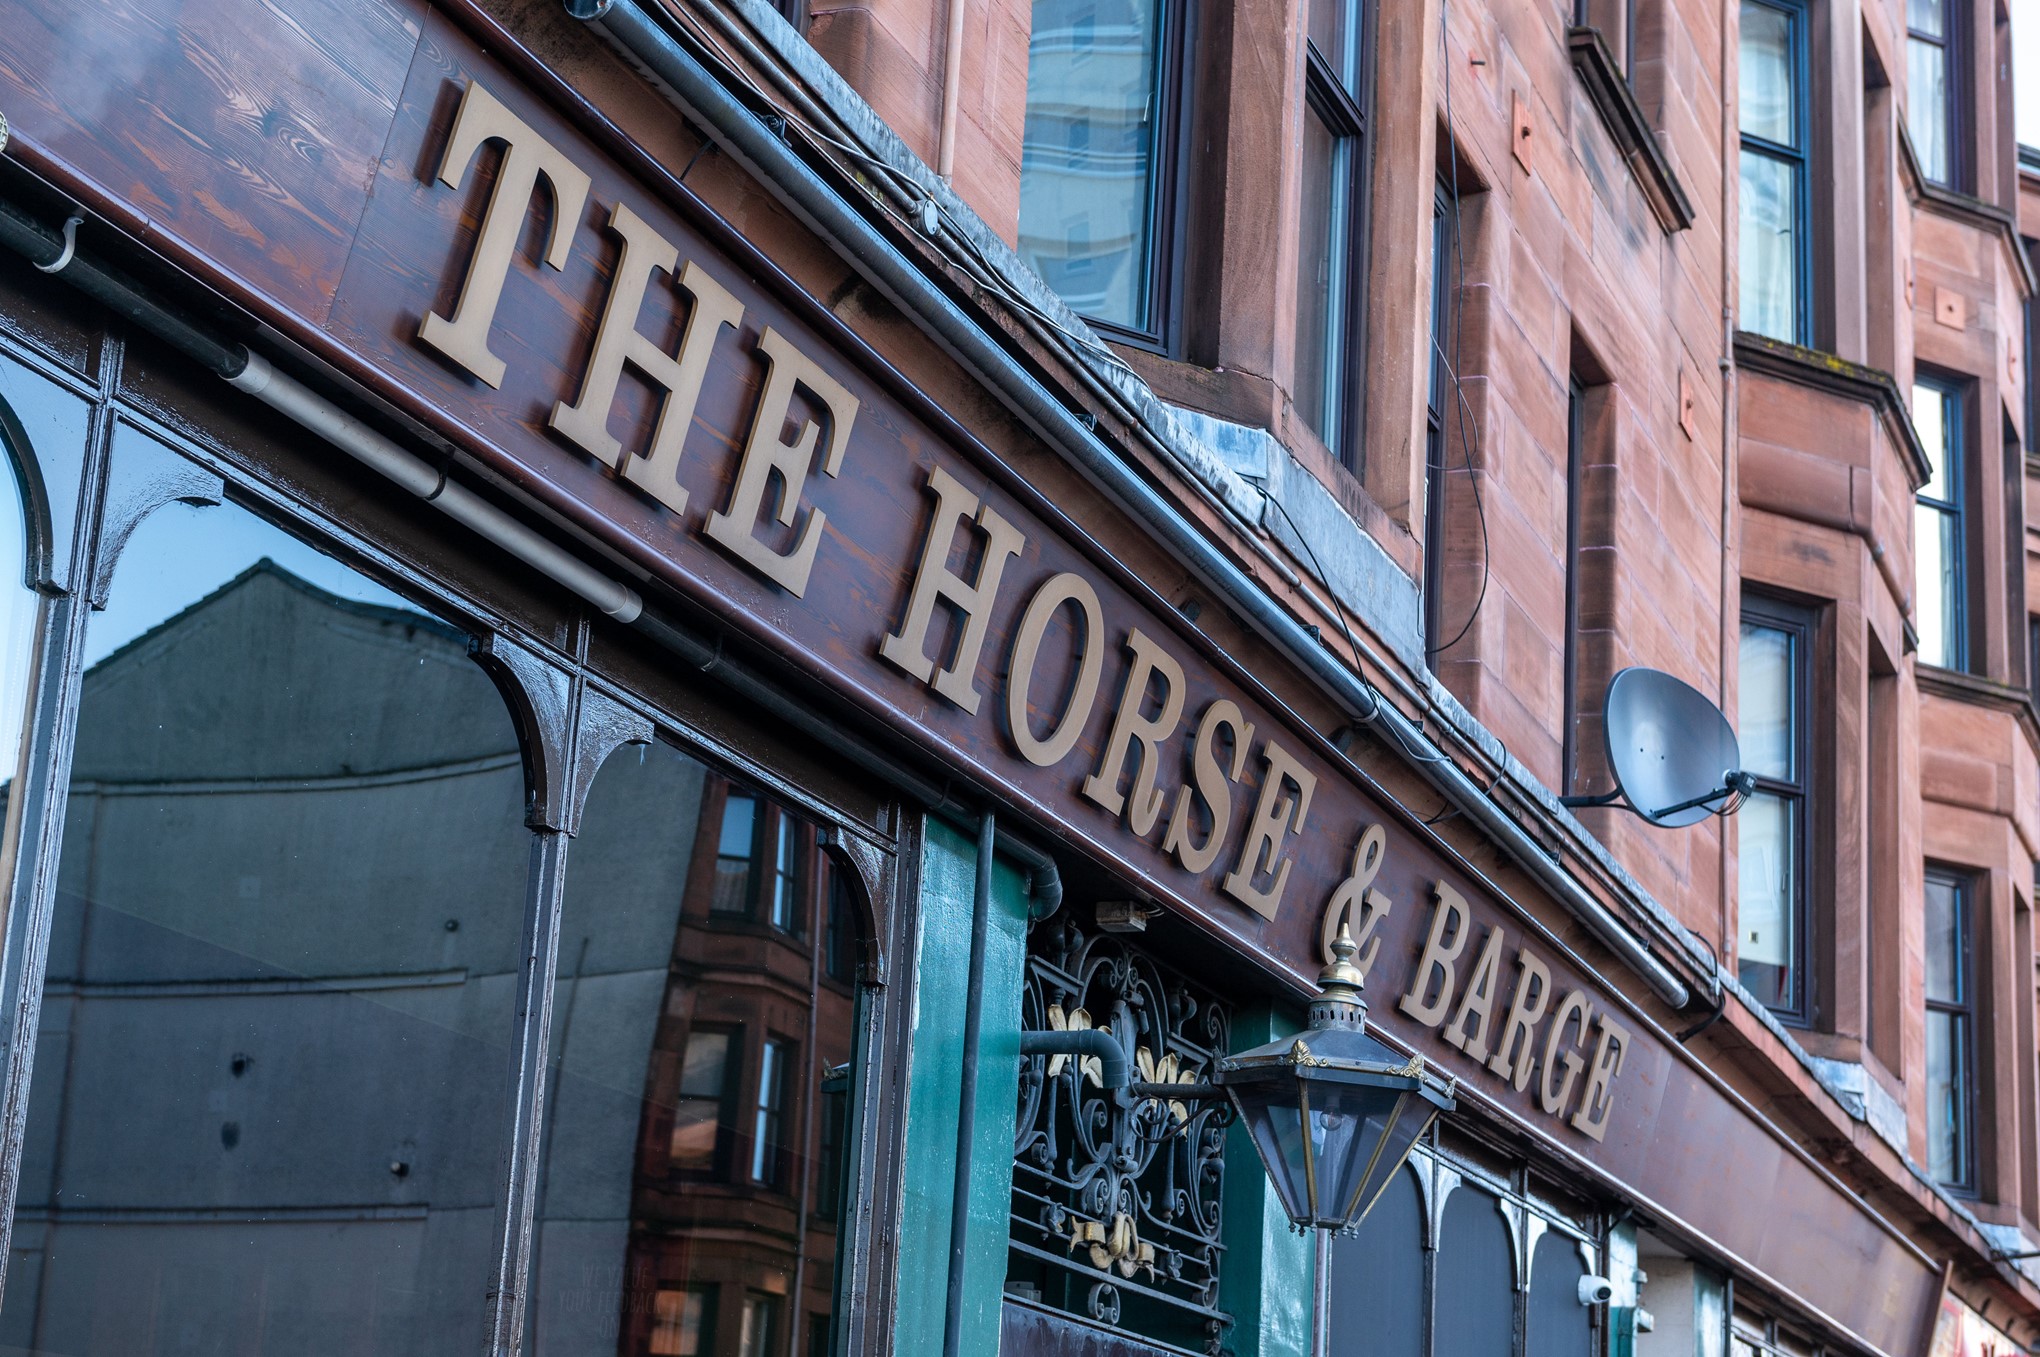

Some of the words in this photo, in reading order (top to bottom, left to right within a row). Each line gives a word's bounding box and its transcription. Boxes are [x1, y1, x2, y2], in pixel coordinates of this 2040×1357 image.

[417, 79, 861, 599] THE
[879, 464, 1318, 923] HORSE
[1321, 823, 1392, 981] &
[1399, 879, 1631, 1144] BARGE
[608, 1265, 649, 1289] VALUE
[559, 1289, 592, 1313] YOUR
[599, 1291, 661, 1314] FEEDBACK
